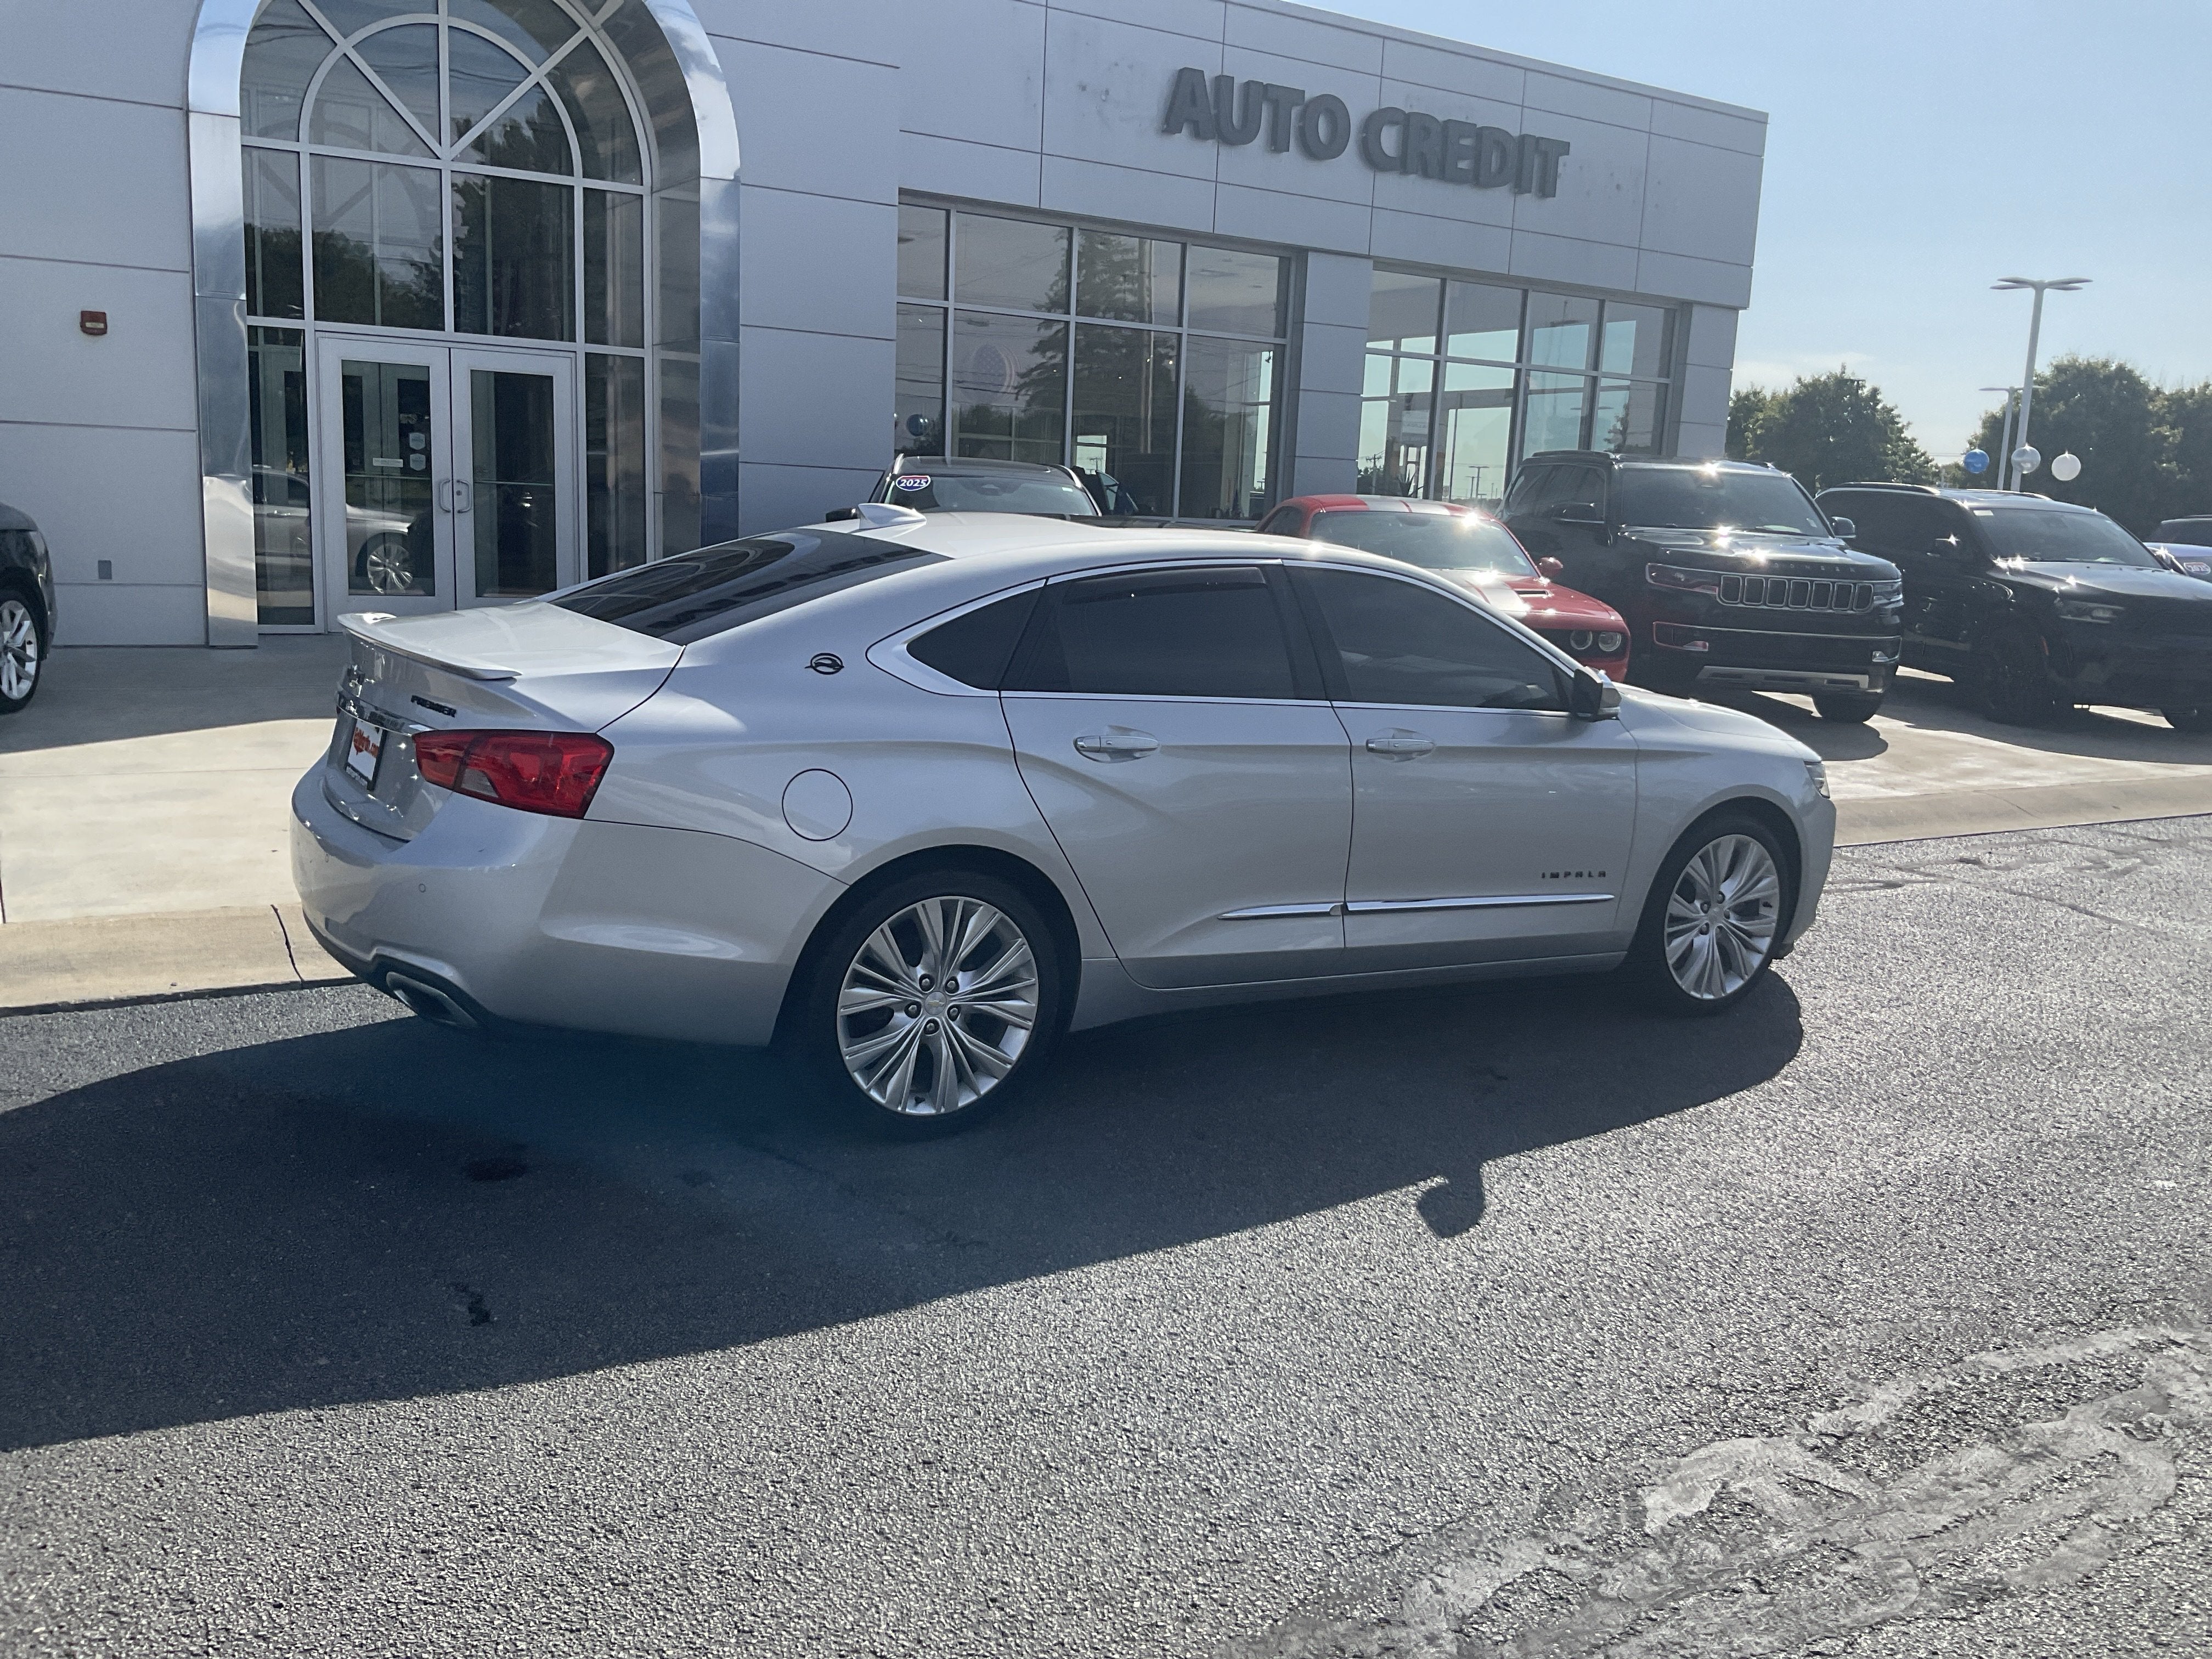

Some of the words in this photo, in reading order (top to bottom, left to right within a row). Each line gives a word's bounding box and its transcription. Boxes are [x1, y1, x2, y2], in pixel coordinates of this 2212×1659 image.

[1163, 66, 1351, 160] AUTO
[1361, 106, 1571, 198] CREDIT
[1541, 870, 1606, 878] IMPALA
